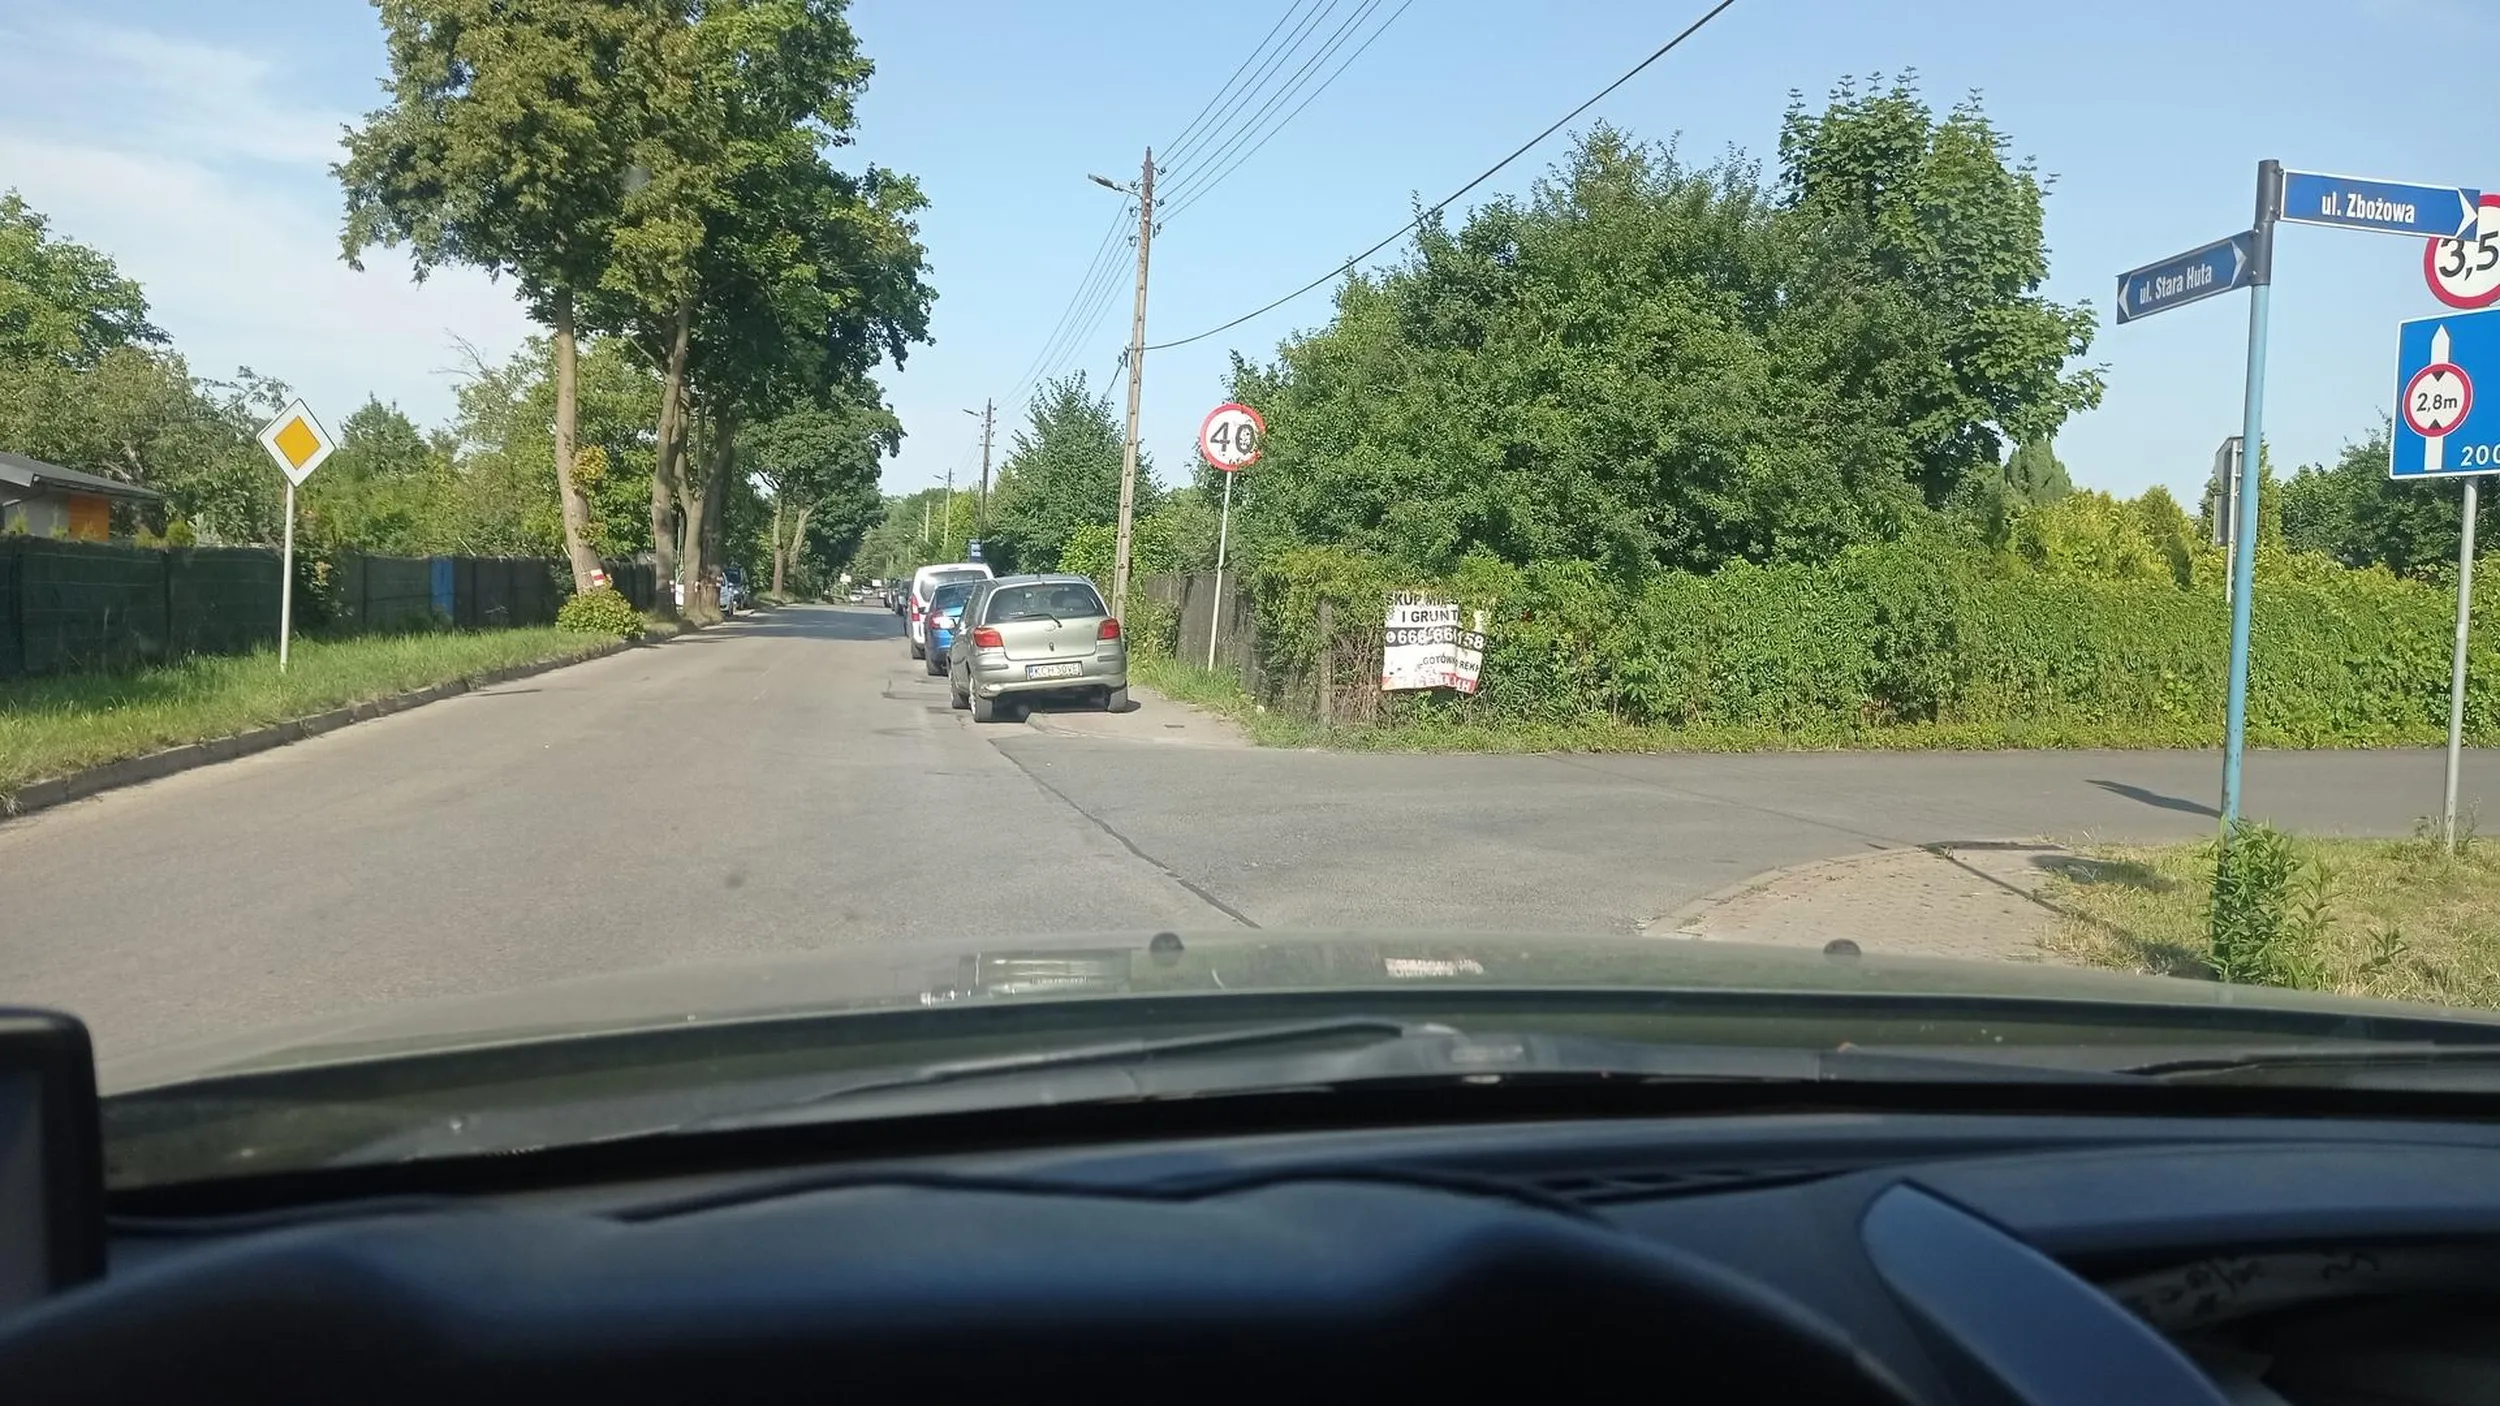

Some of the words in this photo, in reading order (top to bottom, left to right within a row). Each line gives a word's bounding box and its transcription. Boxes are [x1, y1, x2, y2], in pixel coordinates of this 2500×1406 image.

[2321, 192, 2341, 216] ul.
[2347, 193, 2415, 224] Zbożowa
[2139, 281, 2153, 305] ul.
[2155, 274, 2185, 300] Stara
[2186, 263, 2212, 291] Huta
[1210, 421, 1255, 455] 40
